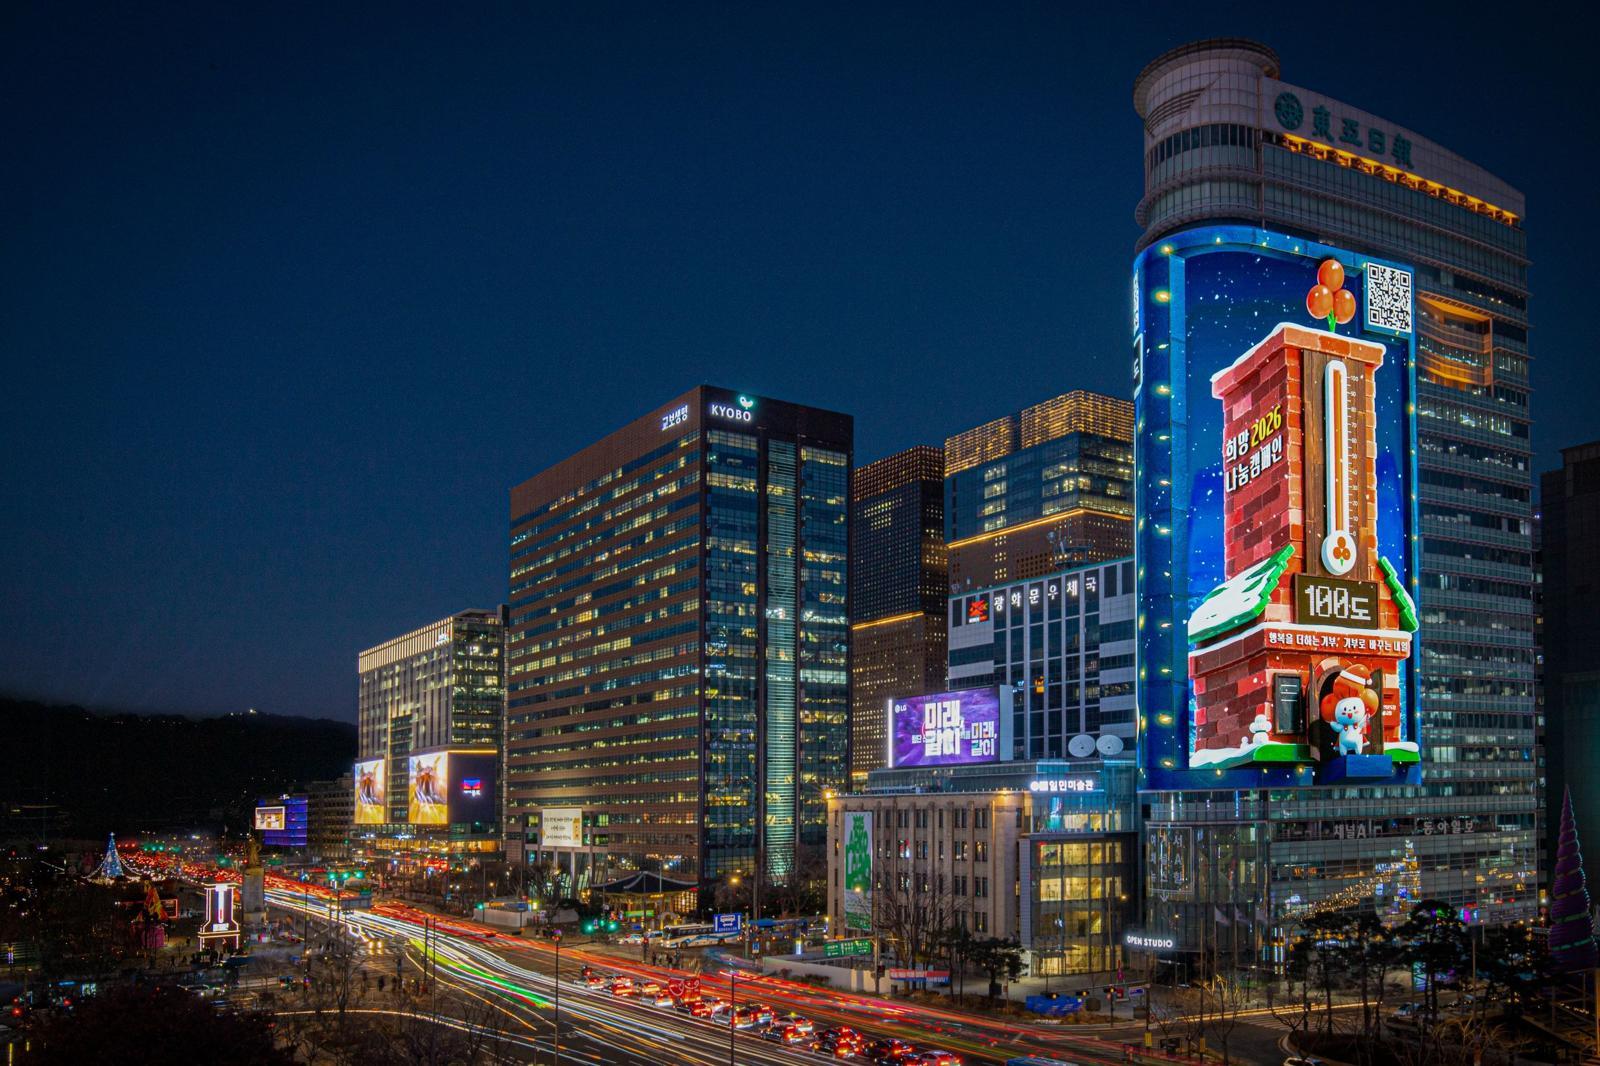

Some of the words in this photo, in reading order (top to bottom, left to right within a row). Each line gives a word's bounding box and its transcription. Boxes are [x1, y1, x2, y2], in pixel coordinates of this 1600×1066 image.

[661, 404, 688, 432] 교보생명
[711, 404, 751, 422] KYOBO
[1226, 428, 1250, 463] 희망
[1251, 404, 1283, 448] 2026
[993, 576, 1097, 612] 광화문우체국
[1304, 584, 1372, 621] 100도
[1269, 632, 1294, 645] 행복을
[1296, 634, 1321, 647] 더하는
[1343, 638, 1368, 649] 기부로
[900, 704, 907, 712] LG
[1423, 819, 1475, 836] 동아일보
[1126, 935, 1143, 946] OPEN
[1143, 937, 1173, 949] STUDIO
